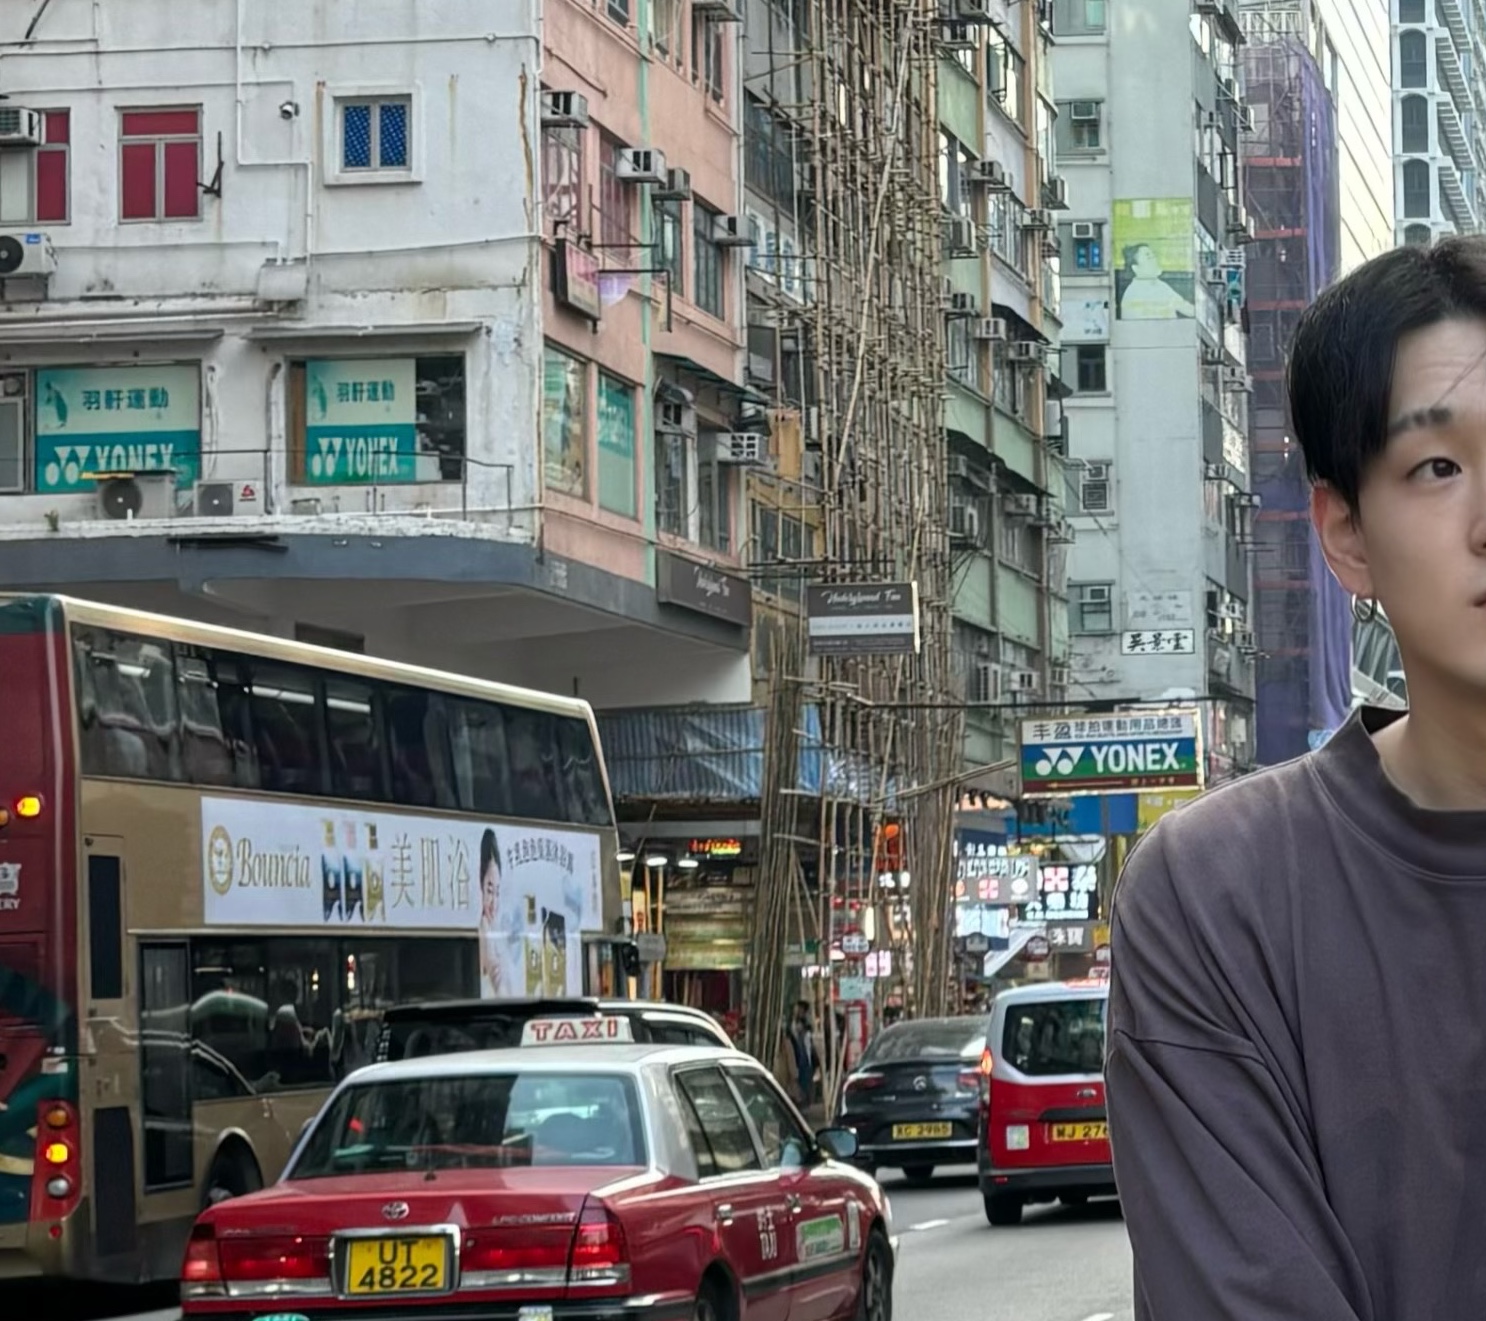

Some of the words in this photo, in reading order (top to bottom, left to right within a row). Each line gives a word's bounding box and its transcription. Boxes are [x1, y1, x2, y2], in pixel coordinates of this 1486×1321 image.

[345, 437, 399, 477] YONEX
[1091, 742, 1180, 773] YONEX
[236, 837, 312, 889] Bouncia
[391, 833, 470, 910] 美肌浴
[531, 1019, 618, 1042] TAXI
[378, 1240, 419, 1265] UT
[358, 1264, 439, 1291] 4822
